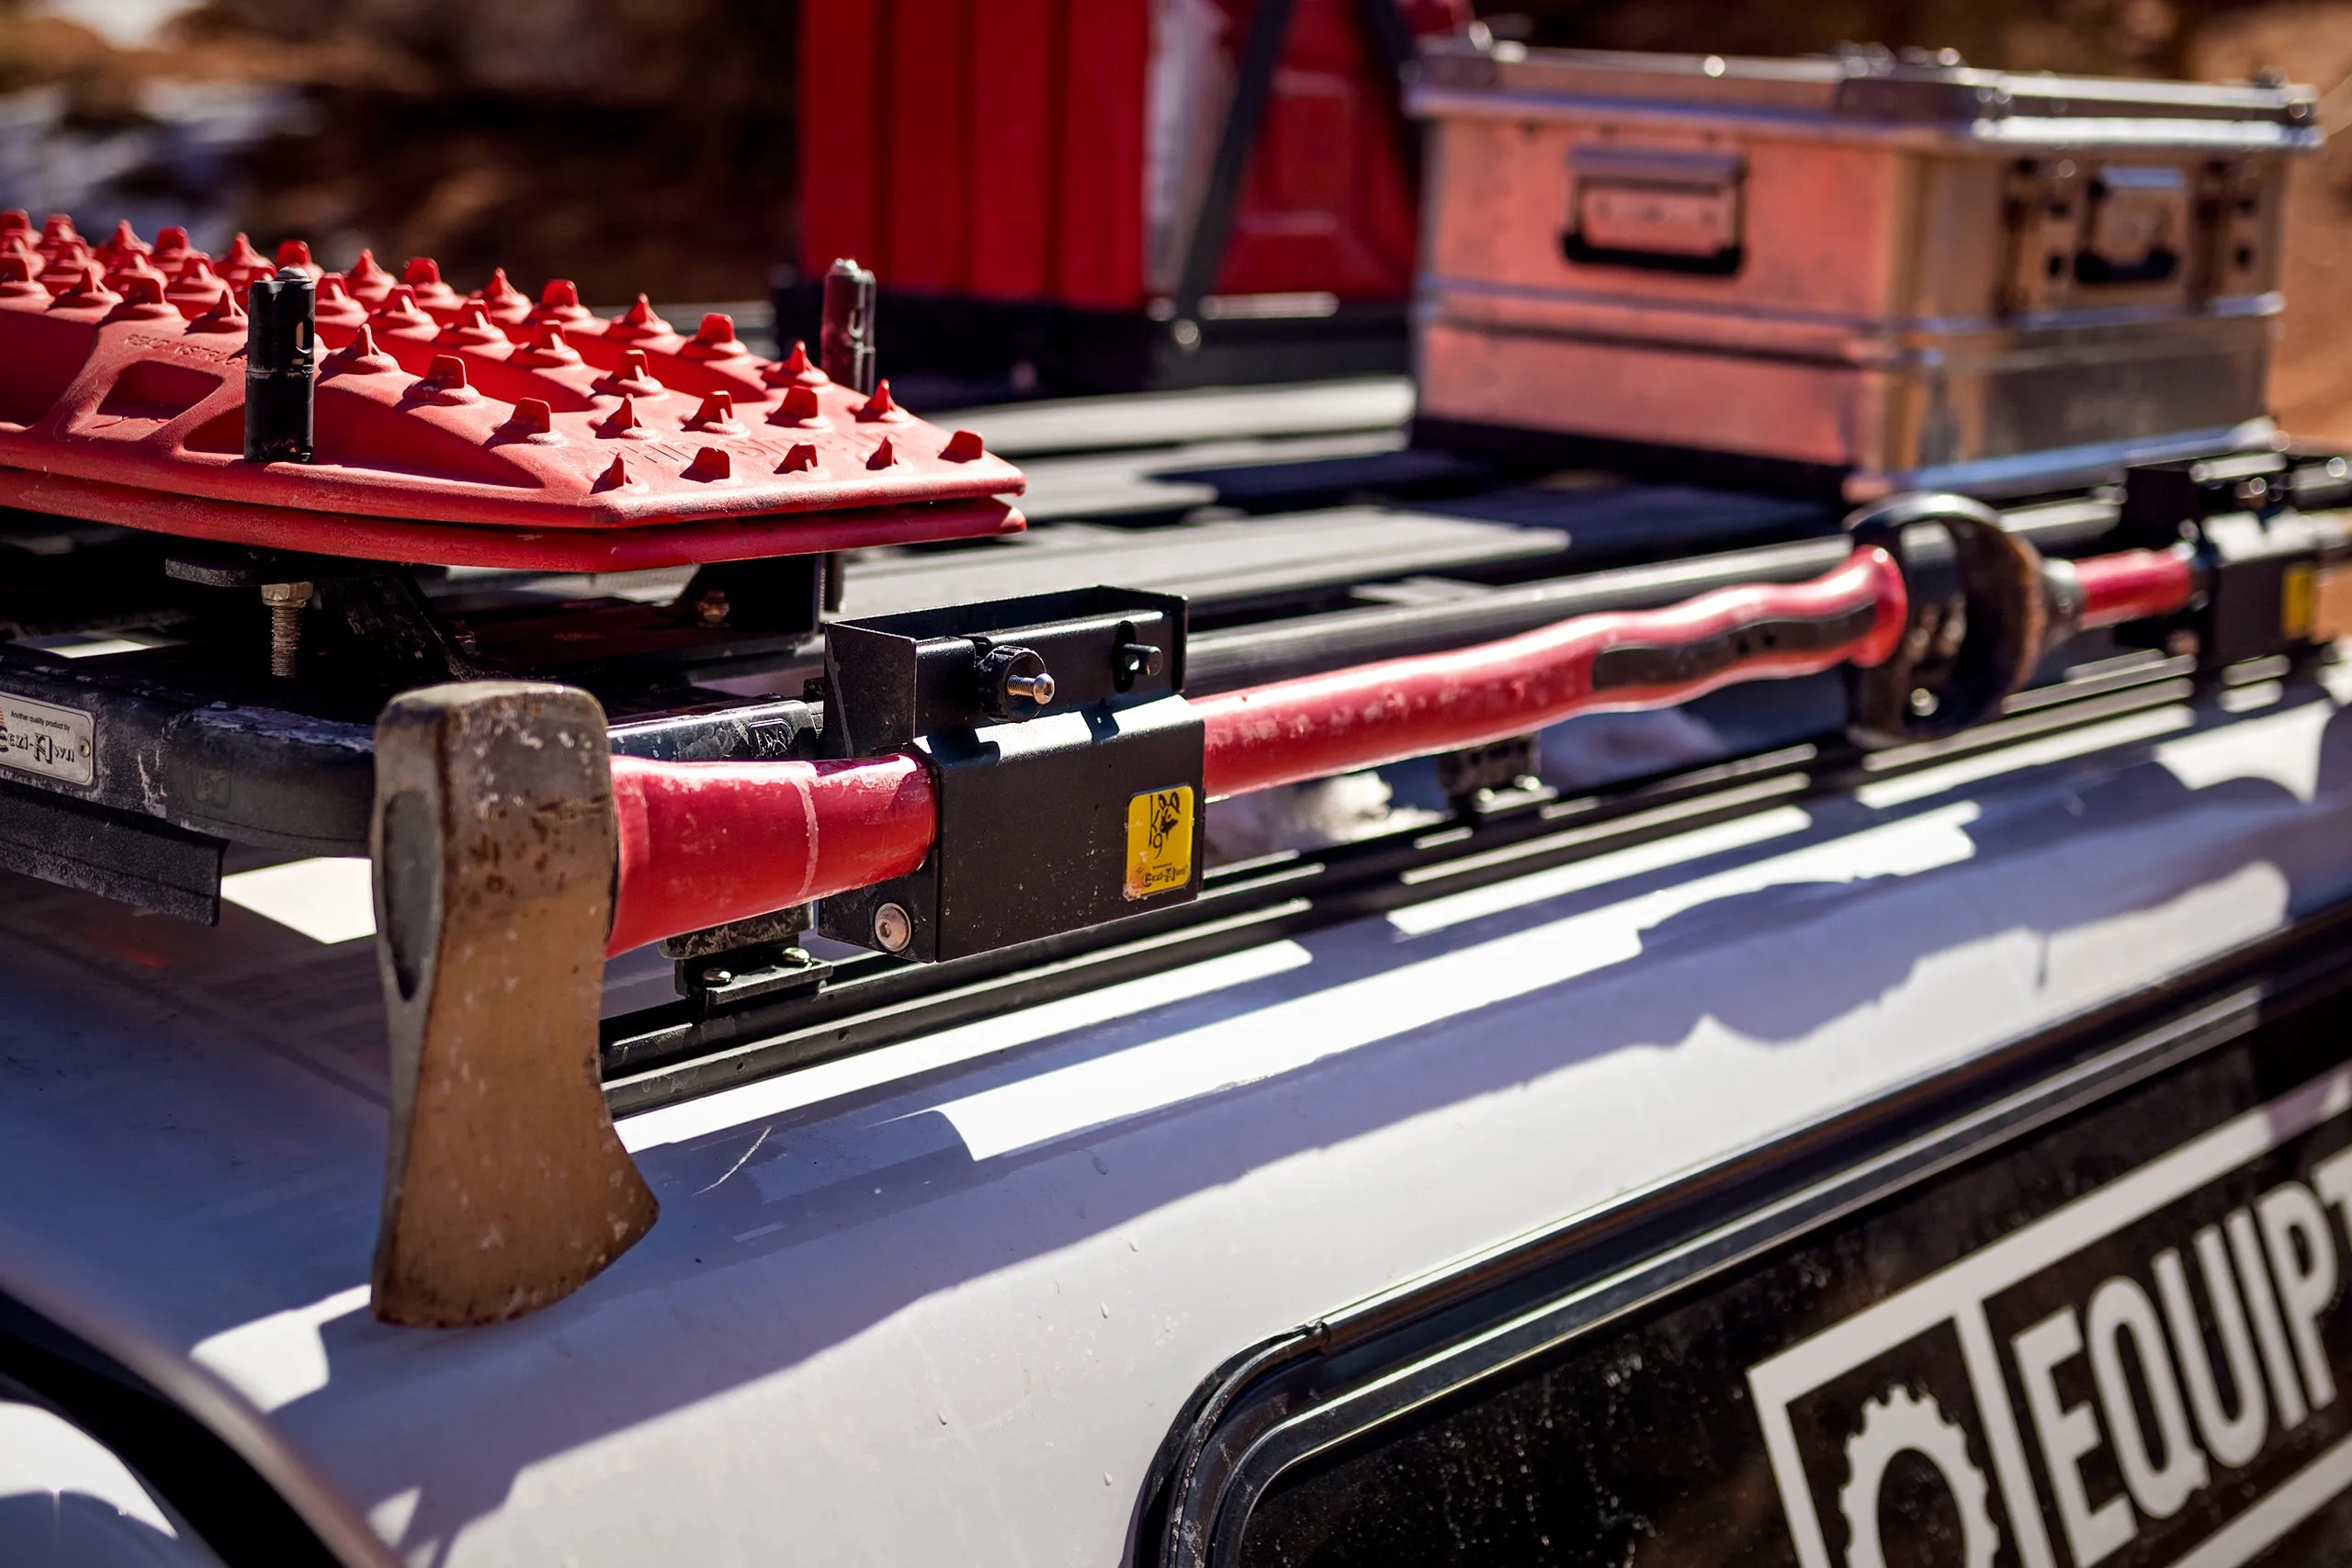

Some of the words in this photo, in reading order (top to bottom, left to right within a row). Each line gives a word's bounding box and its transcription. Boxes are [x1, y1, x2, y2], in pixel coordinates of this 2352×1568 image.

[168, 342, 248, 366] INSTRUC
[10, 710, 28, 722] Another
[29, 716, 45, 727] quality
[45, 720, 63, 729] product
[63, 724, 71, 732] by
